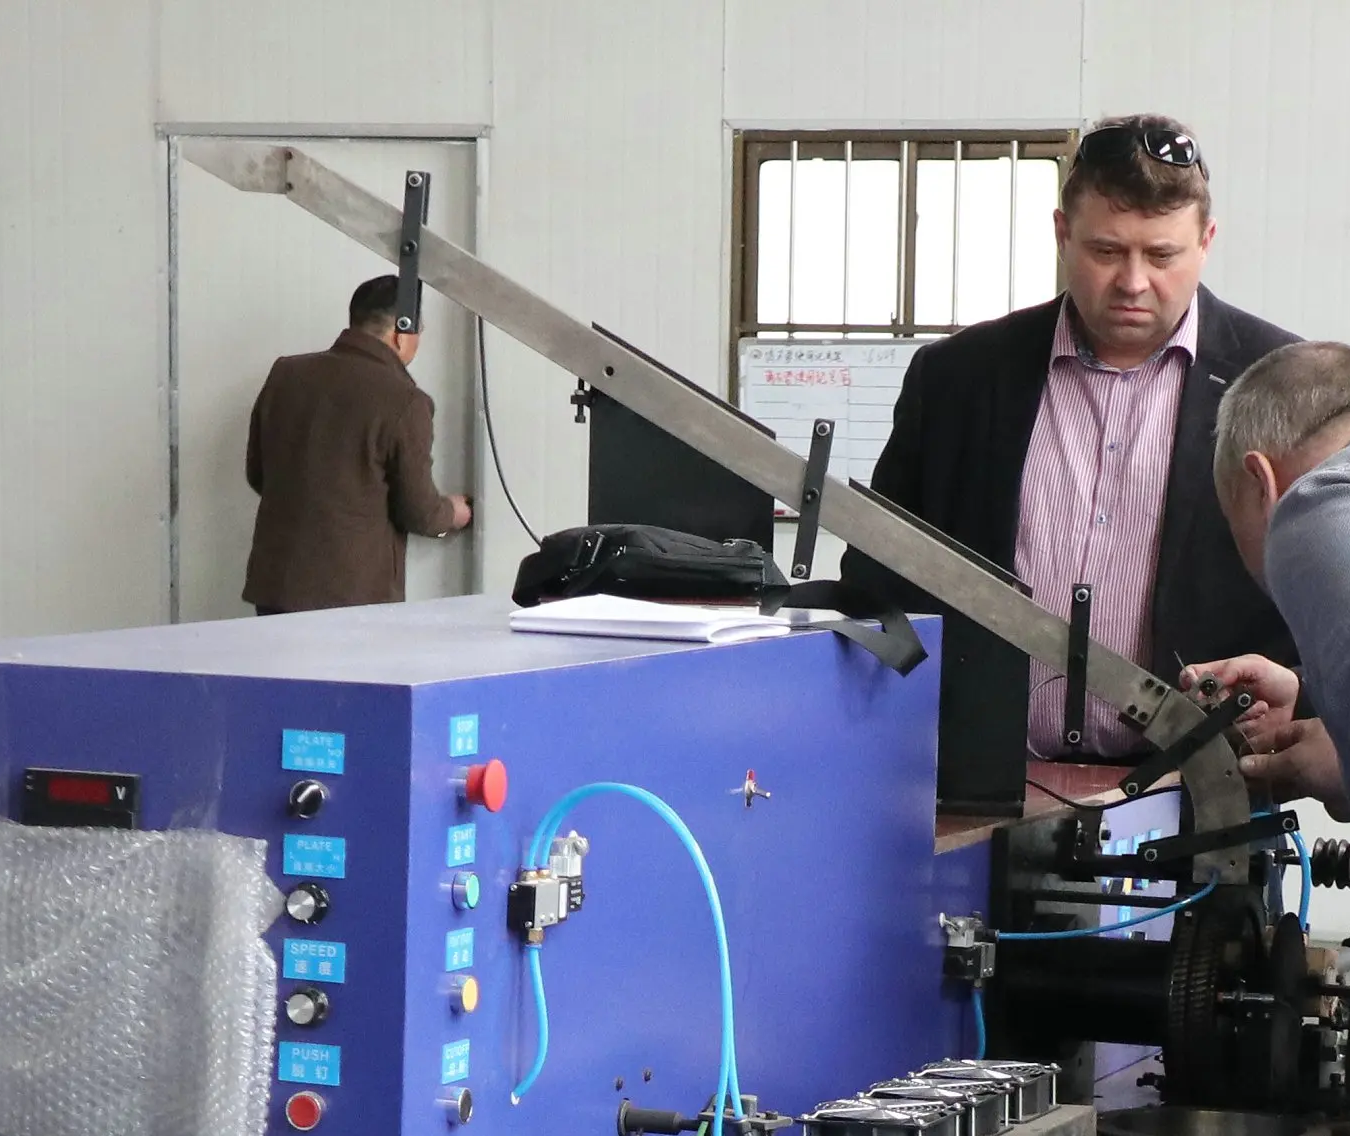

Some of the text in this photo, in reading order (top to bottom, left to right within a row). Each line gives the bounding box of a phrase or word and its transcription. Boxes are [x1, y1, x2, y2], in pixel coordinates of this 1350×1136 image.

[297, 734, 334, 747] PLATE
[115, 786, 126, 800] V
[297, 839, 333, 851] PLATE
[290, 942, 337, 957] SPEED
[291, 1047, 330, 1062] PUSH
